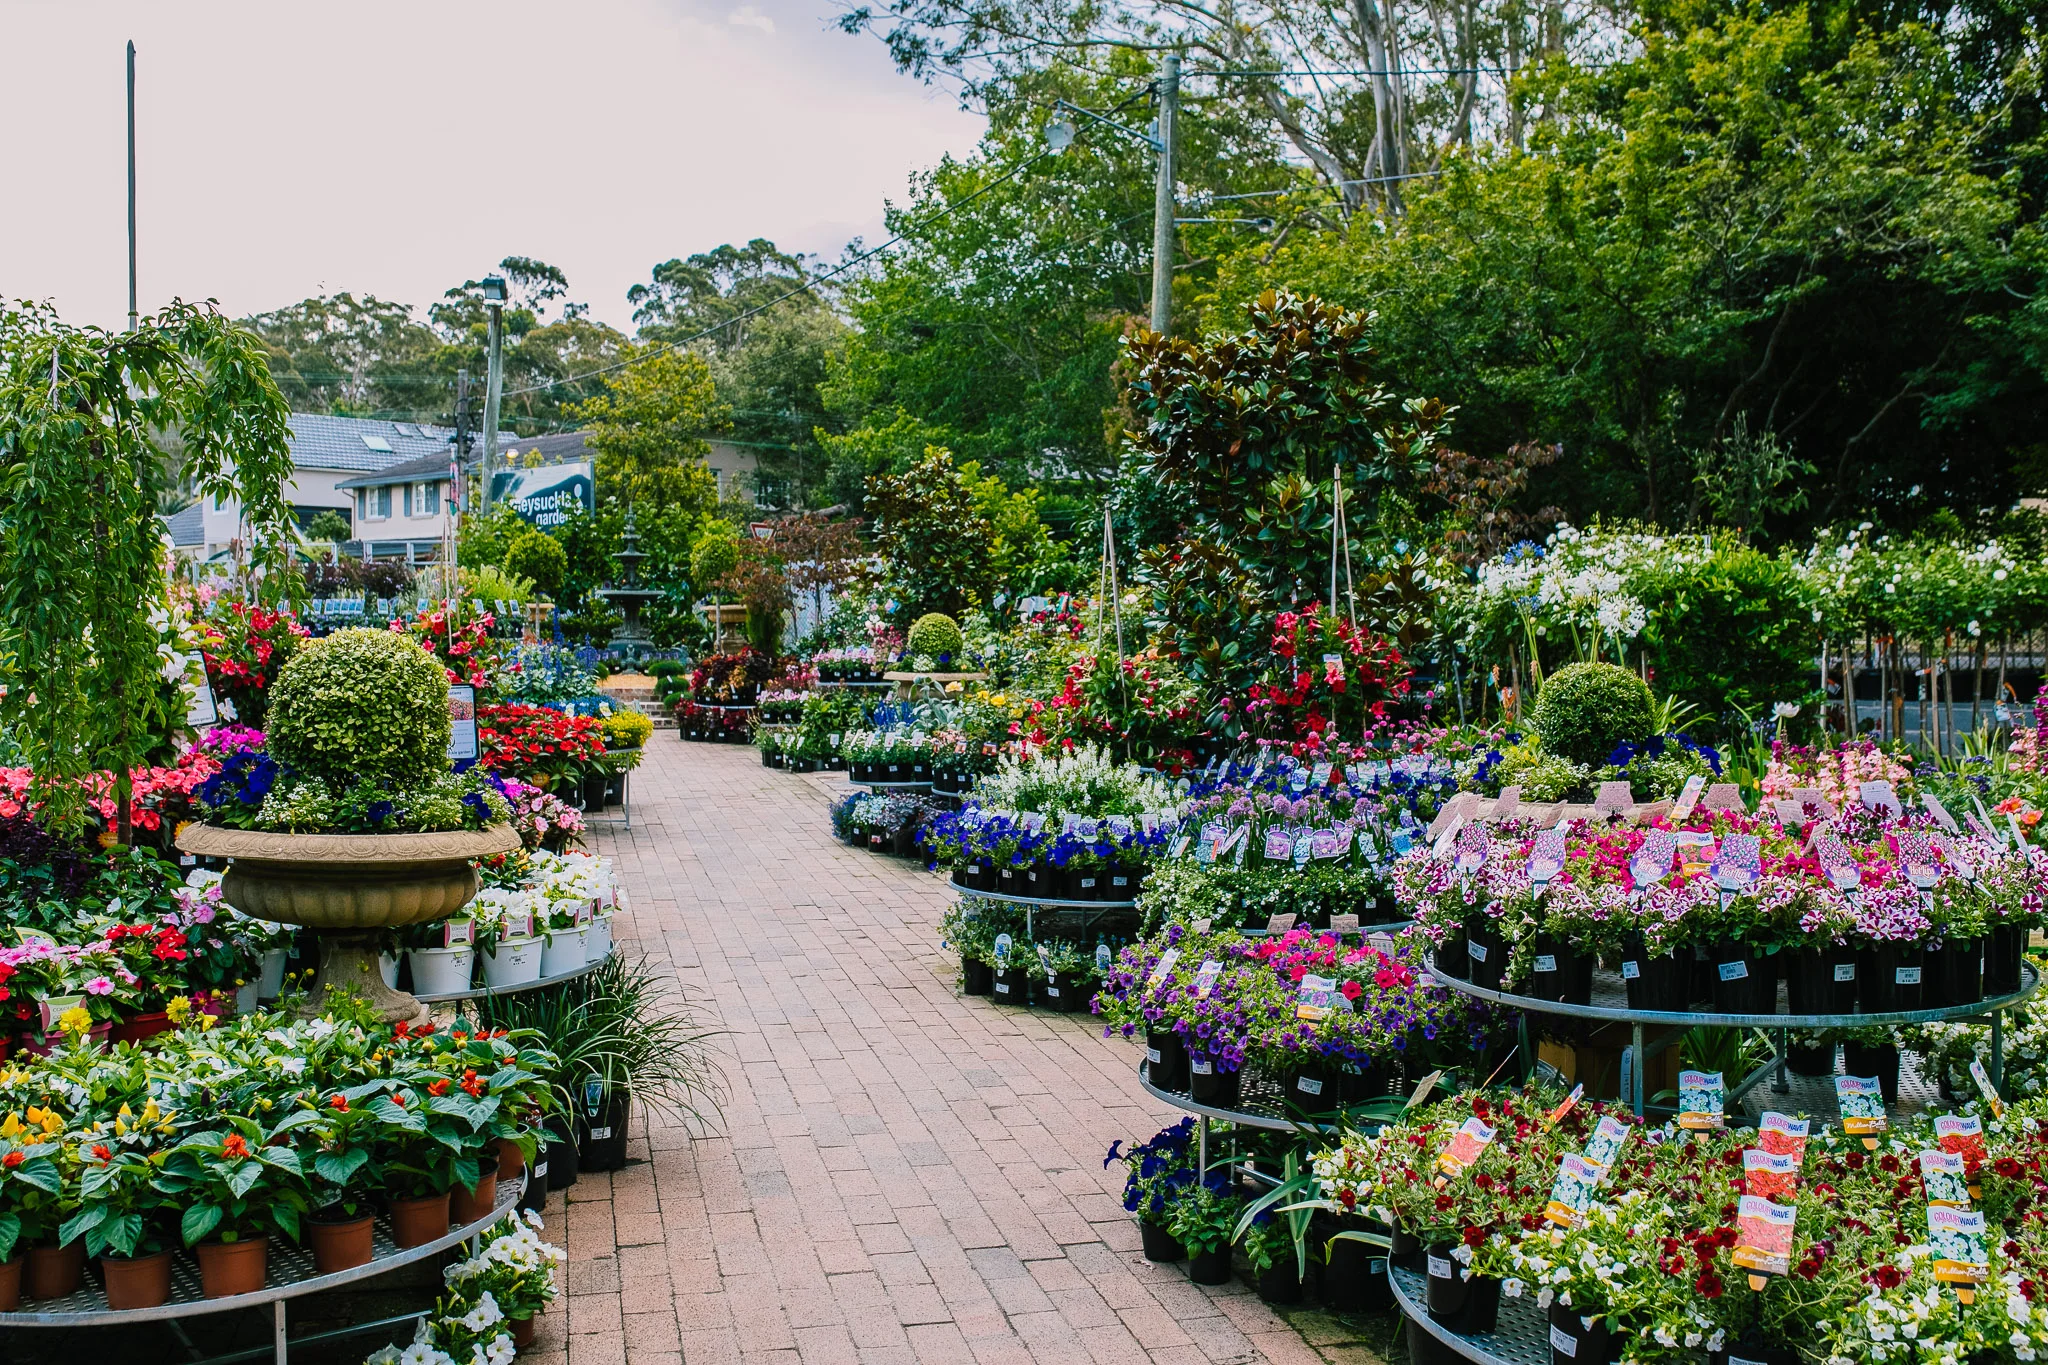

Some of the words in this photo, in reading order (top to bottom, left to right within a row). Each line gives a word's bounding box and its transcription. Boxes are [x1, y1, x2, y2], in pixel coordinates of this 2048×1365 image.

[1684, 1074, 1718, 1086] COLOURWAVE
[1841, 1080, 1875, 1090] COLOURWAVE
[1766, 1116, 1804, 1131] COLOURWAVE
[1940, 1120, 1977, 1131] COLOURWAVE
[1750, 1154, 1788, 1168] COLOURWAVE
[1925, 1155, 1959, 1168] COLOURWAVE
[1746, 1201, 1789, 1219] COLOURWAVE
[1934, 1211, 1978, 1227] COLOURWAVE
